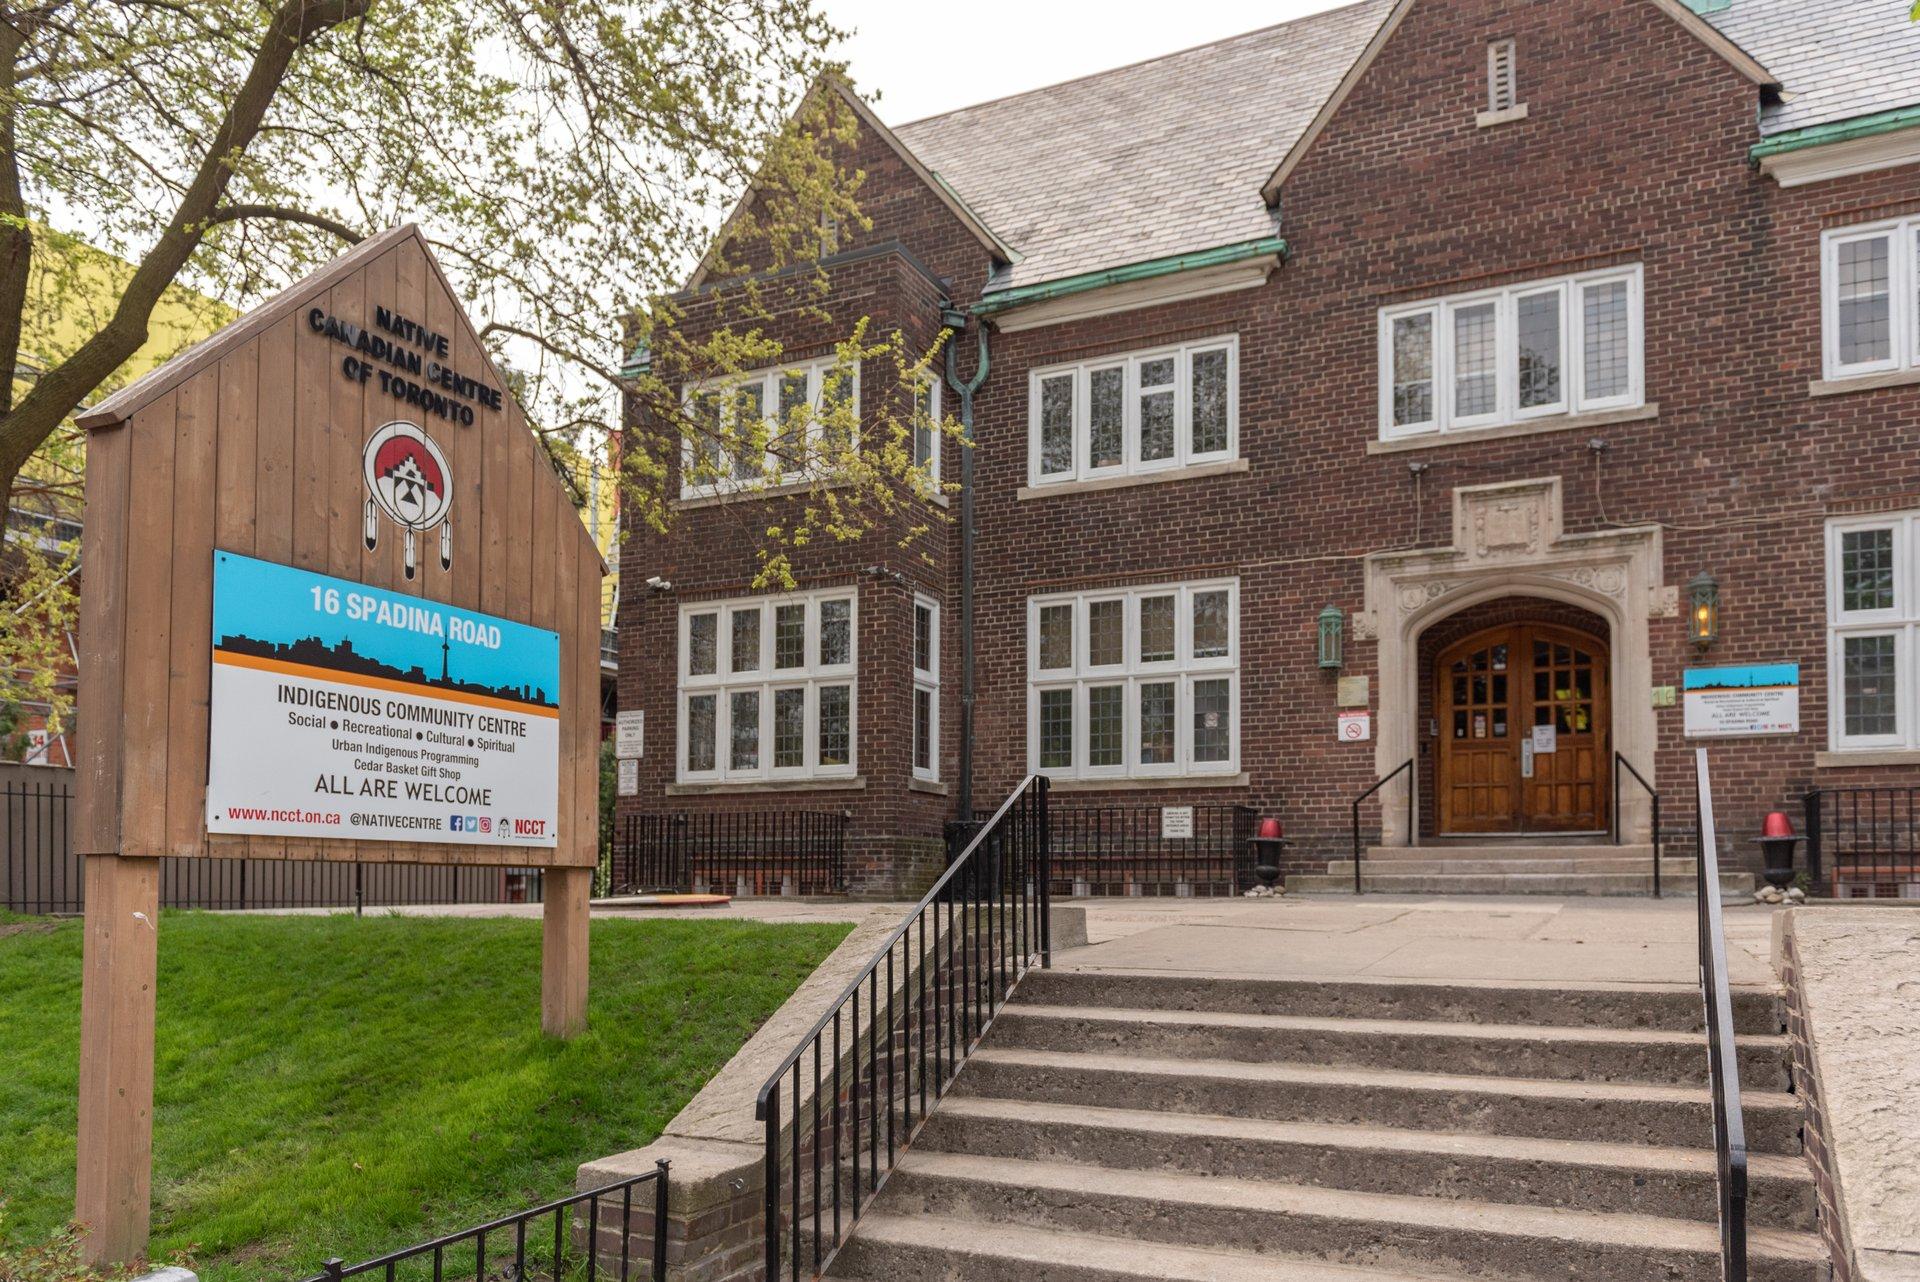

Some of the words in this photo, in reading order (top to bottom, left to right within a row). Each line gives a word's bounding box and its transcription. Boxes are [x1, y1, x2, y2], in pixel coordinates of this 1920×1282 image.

[376, 305, 448, 358] NATIVE
[309, 308, 421, 375] CANADIAN
[427, 362, 502, 410] CENTRE
[343, 356, 373, 384] OF
[379, 370, 474, 426] TORONTO
[310, 585, 340, 615] 16
[346, 592, 444, 638] SPADINA
[451, 616, 501, 650] ROAD
[278, 684, 381, 716] INDIGENOUS
[386, 701, 474, 730] COMMUNITY
[478, 715, 527, 738] CENTRE
[288, 711, 326, 729] Social
[342, 719, 412, 740] Recreational
[426, 730, 465, 747] Cultural
[477, 737, 515, 753] Spiritual
[332, 739, 363, 753] Urban
[366, 742, 419, 759] Indigenous
[421, 749, 480, 768] Programming
[354, 758, 383, 772] Cedar
[386, 762, 419, 776] Basket
[421, 765, 437, 778] Gift
[439, 768, 461, 781] Shop
[314, 773, 354, 795] ALL
[359, 777, 398, 799] ARE
[405, 781, 492, 806] WELCOME
[228, 807, 341, 825] www.ncct.on.ca
[350, 812, 442, 830] @NATIVECENTRE
[515, 819, 546, 835] NCCT
